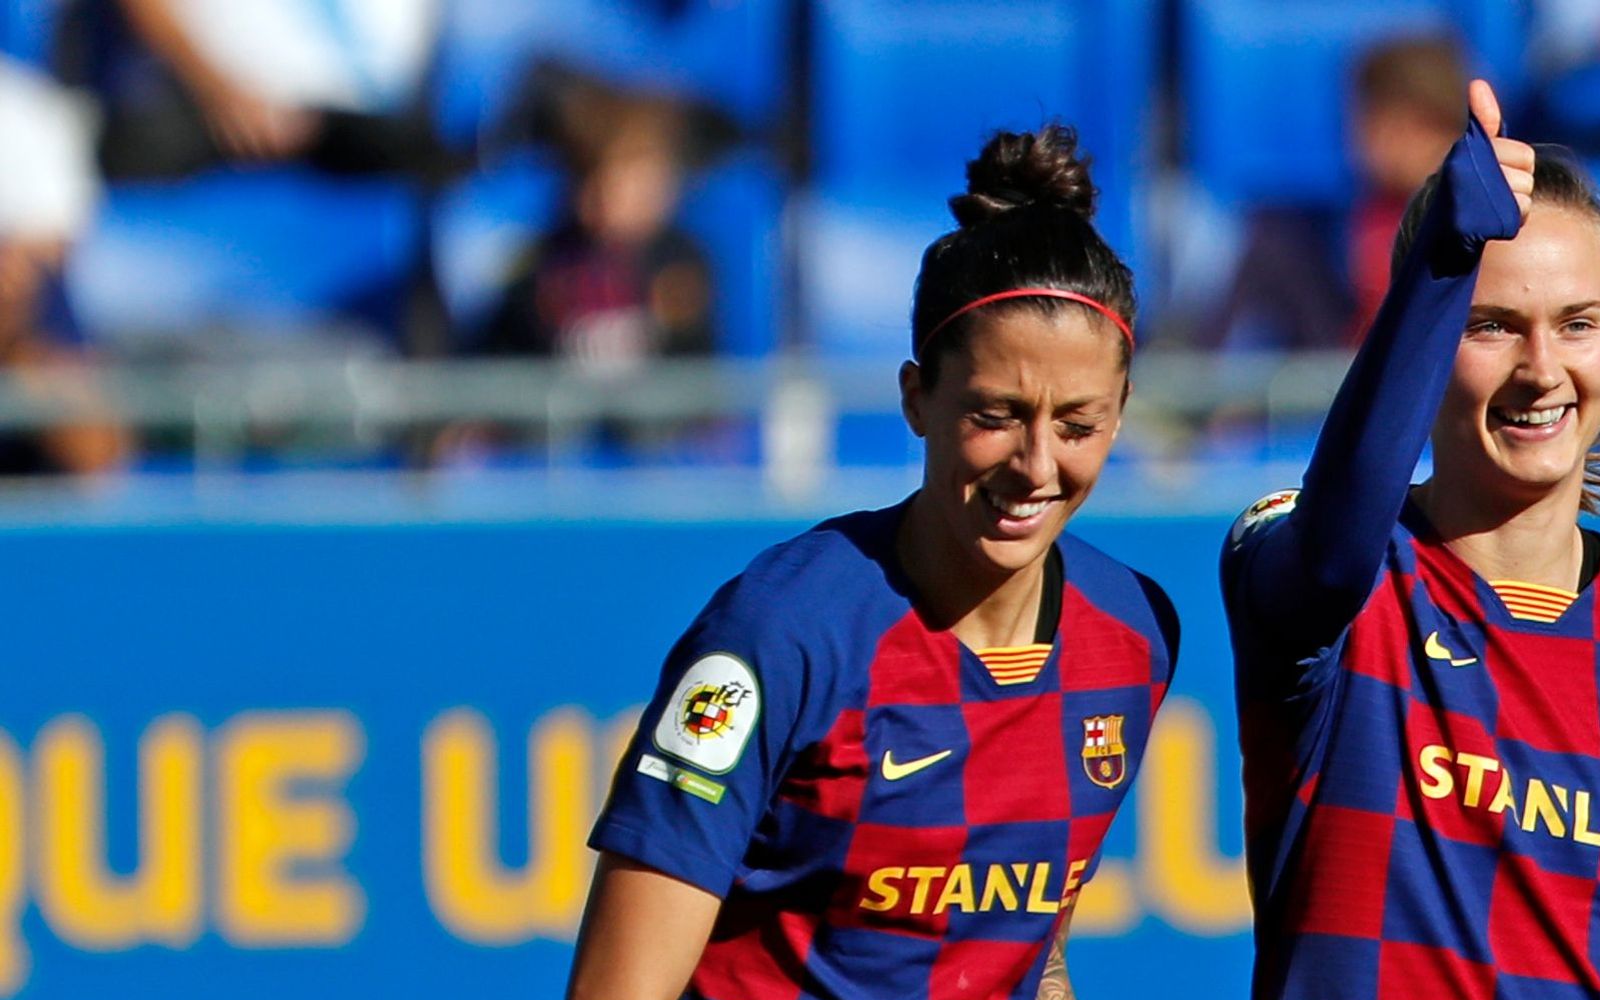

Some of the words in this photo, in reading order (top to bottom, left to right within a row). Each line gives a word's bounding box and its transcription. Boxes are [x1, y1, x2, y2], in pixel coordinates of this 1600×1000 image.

[0, 706, 368, 996] UE
[420, 703, 646, 946] U
[859, 859, 1087, 914] STANLE
